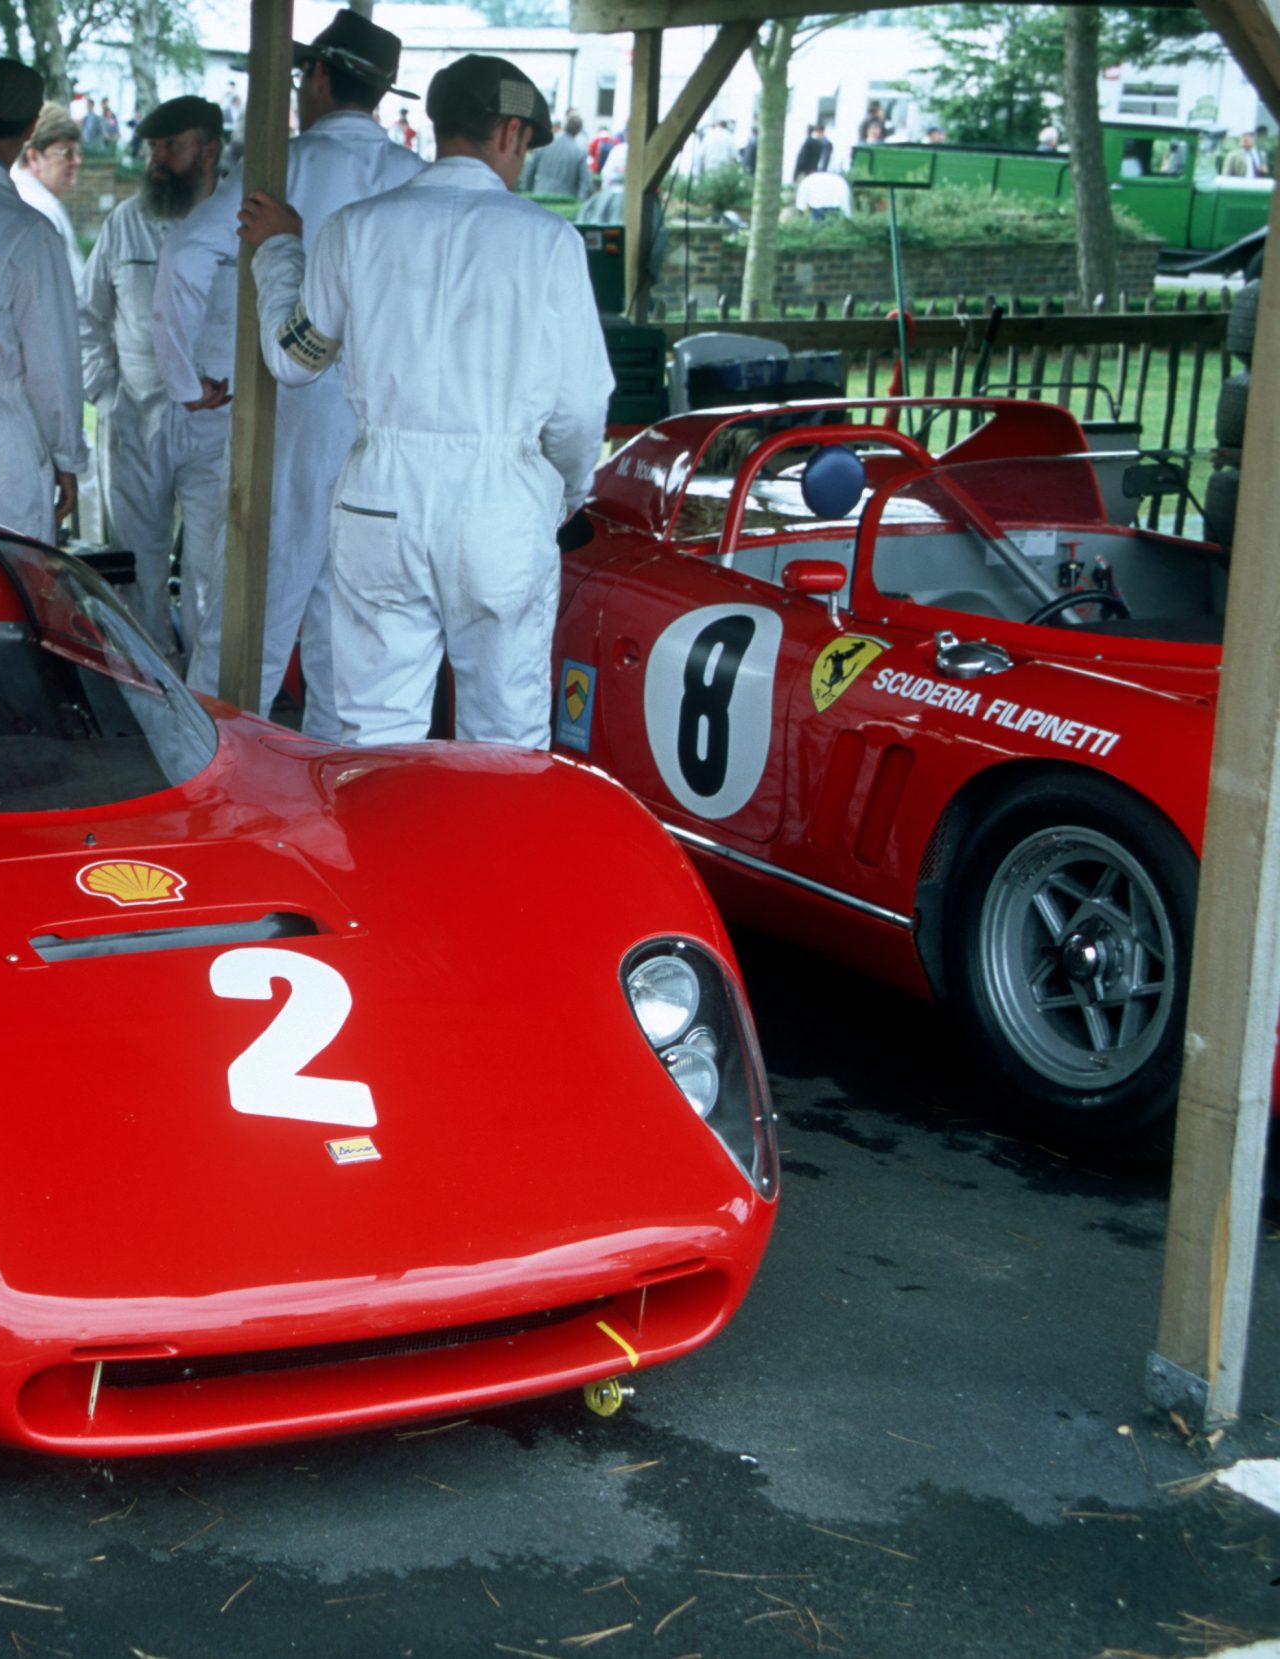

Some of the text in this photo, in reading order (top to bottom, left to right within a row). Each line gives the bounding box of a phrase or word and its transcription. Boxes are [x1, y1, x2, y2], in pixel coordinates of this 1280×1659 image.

[678, 614, 758, 798] 8
[872, 667, 1121, 757] SCUDERIA FILIPINETTI
[209, 946, 378, 1129] 2
